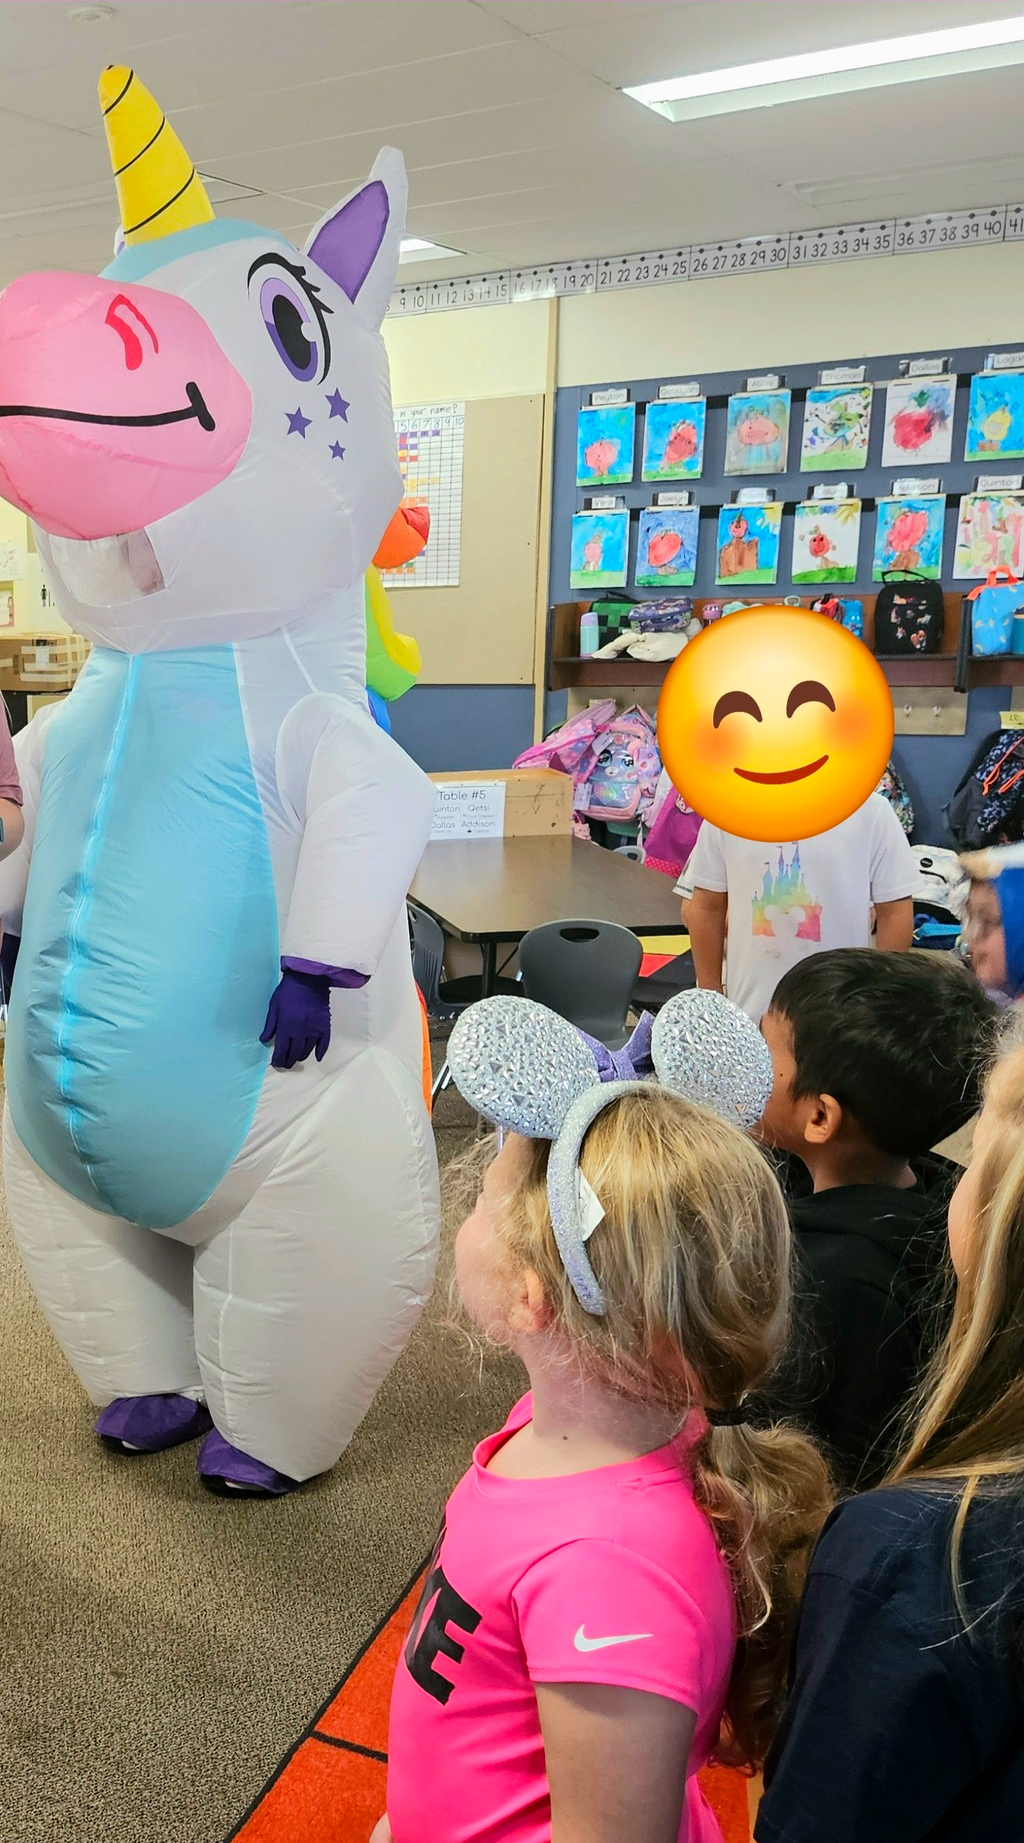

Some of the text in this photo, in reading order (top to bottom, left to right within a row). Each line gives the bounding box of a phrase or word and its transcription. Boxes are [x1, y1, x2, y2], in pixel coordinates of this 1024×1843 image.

[400, 297, 406, 309] 9
[413, 295, 425, 308] 10
[431, 293, 440, 305] 11
[447, 291, 457, 303] 12
[463, 288, 474, 301] 13
[480, 286, 490, 299] 14
[496, 284, 507, 297] 15
[515, 282, 525, 294] 16
[531, 279, 541, 292] 17
[564, 275, 576, 288] 19
[581, 273, 594, 287] 20
[600, 271, 612, 285] 21
[617, 268, 631, 283] 22
[635, 266, 649, 280] 23
[653, 263, 668, 278] 24
[672, 260, 687, 276] 25
[693, 258, 708, 272] 26
[712, 255, 727, 270] 27
[730, 253, 746, 268] 28
[750, 250, 766, 265] 29
[770, 247, 786, 262] 30
[793, 246, 807, 260] 31
[811, 243, 827, 258] 32
[832, 240, 848, 255] 33
[852, 237, 869, 252] 34
[873, 235, 891, 250] 35
[897, 231, 914, 246] 36
[919, 228, 936, 244] 37
[939, 226, 957, 242] 38
[961, 223, 979, 239] 39
[984, 221, 1002, 236] 40
[1009, 218, 1024, 233] 41
[825, 371, 861, 381] Thomas
[595, 393, 624, 404] Peyton
[410, 408, 427, 418] your
[430, 403, 458, 415] name?
[401, 416, 465, 432] 5 6 7 8 9 10
[439, 789, 486, 801] Table #5
[434, 804, 490, 813] uinton Qetsi
[460, 820, 496, 828] Addison
